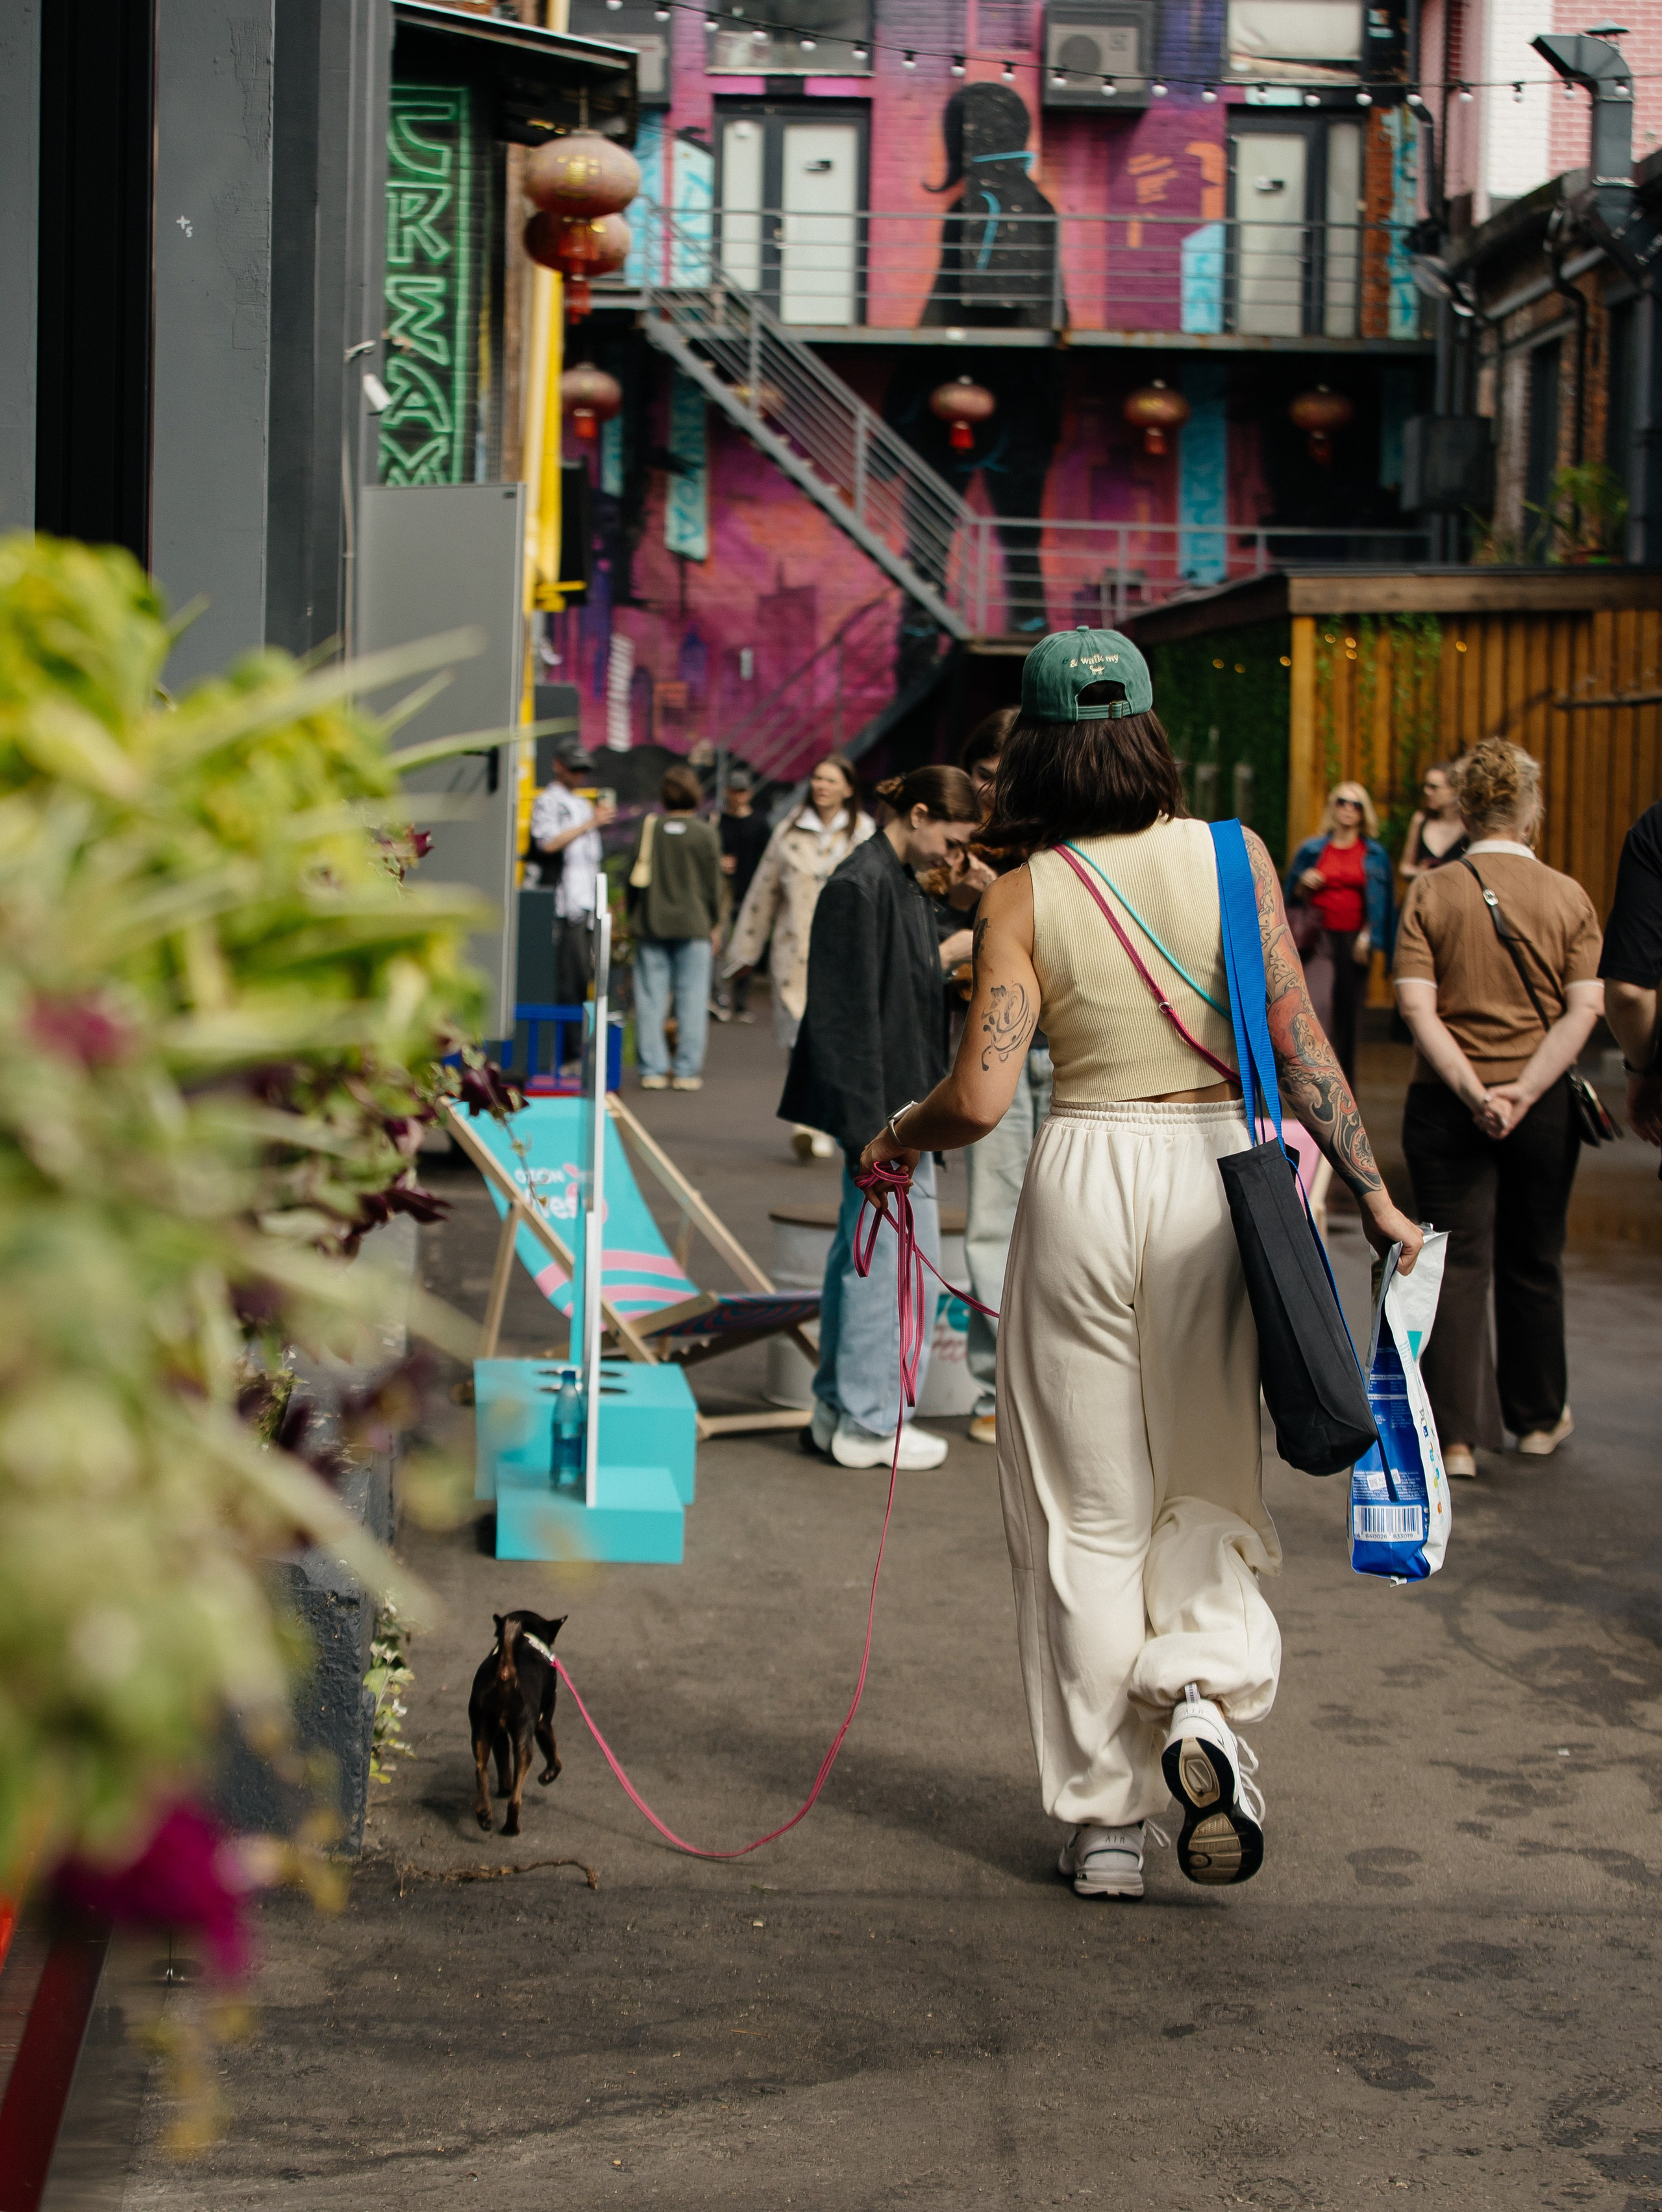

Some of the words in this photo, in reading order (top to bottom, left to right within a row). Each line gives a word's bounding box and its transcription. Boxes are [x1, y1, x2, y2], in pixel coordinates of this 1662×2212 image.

[1070, 658, 1078, 668] &
[1080, 653, 1104, 665] walk
[1105, 653, 1119, 664] my
[1105, 1835, 1125, 1844] AIR
